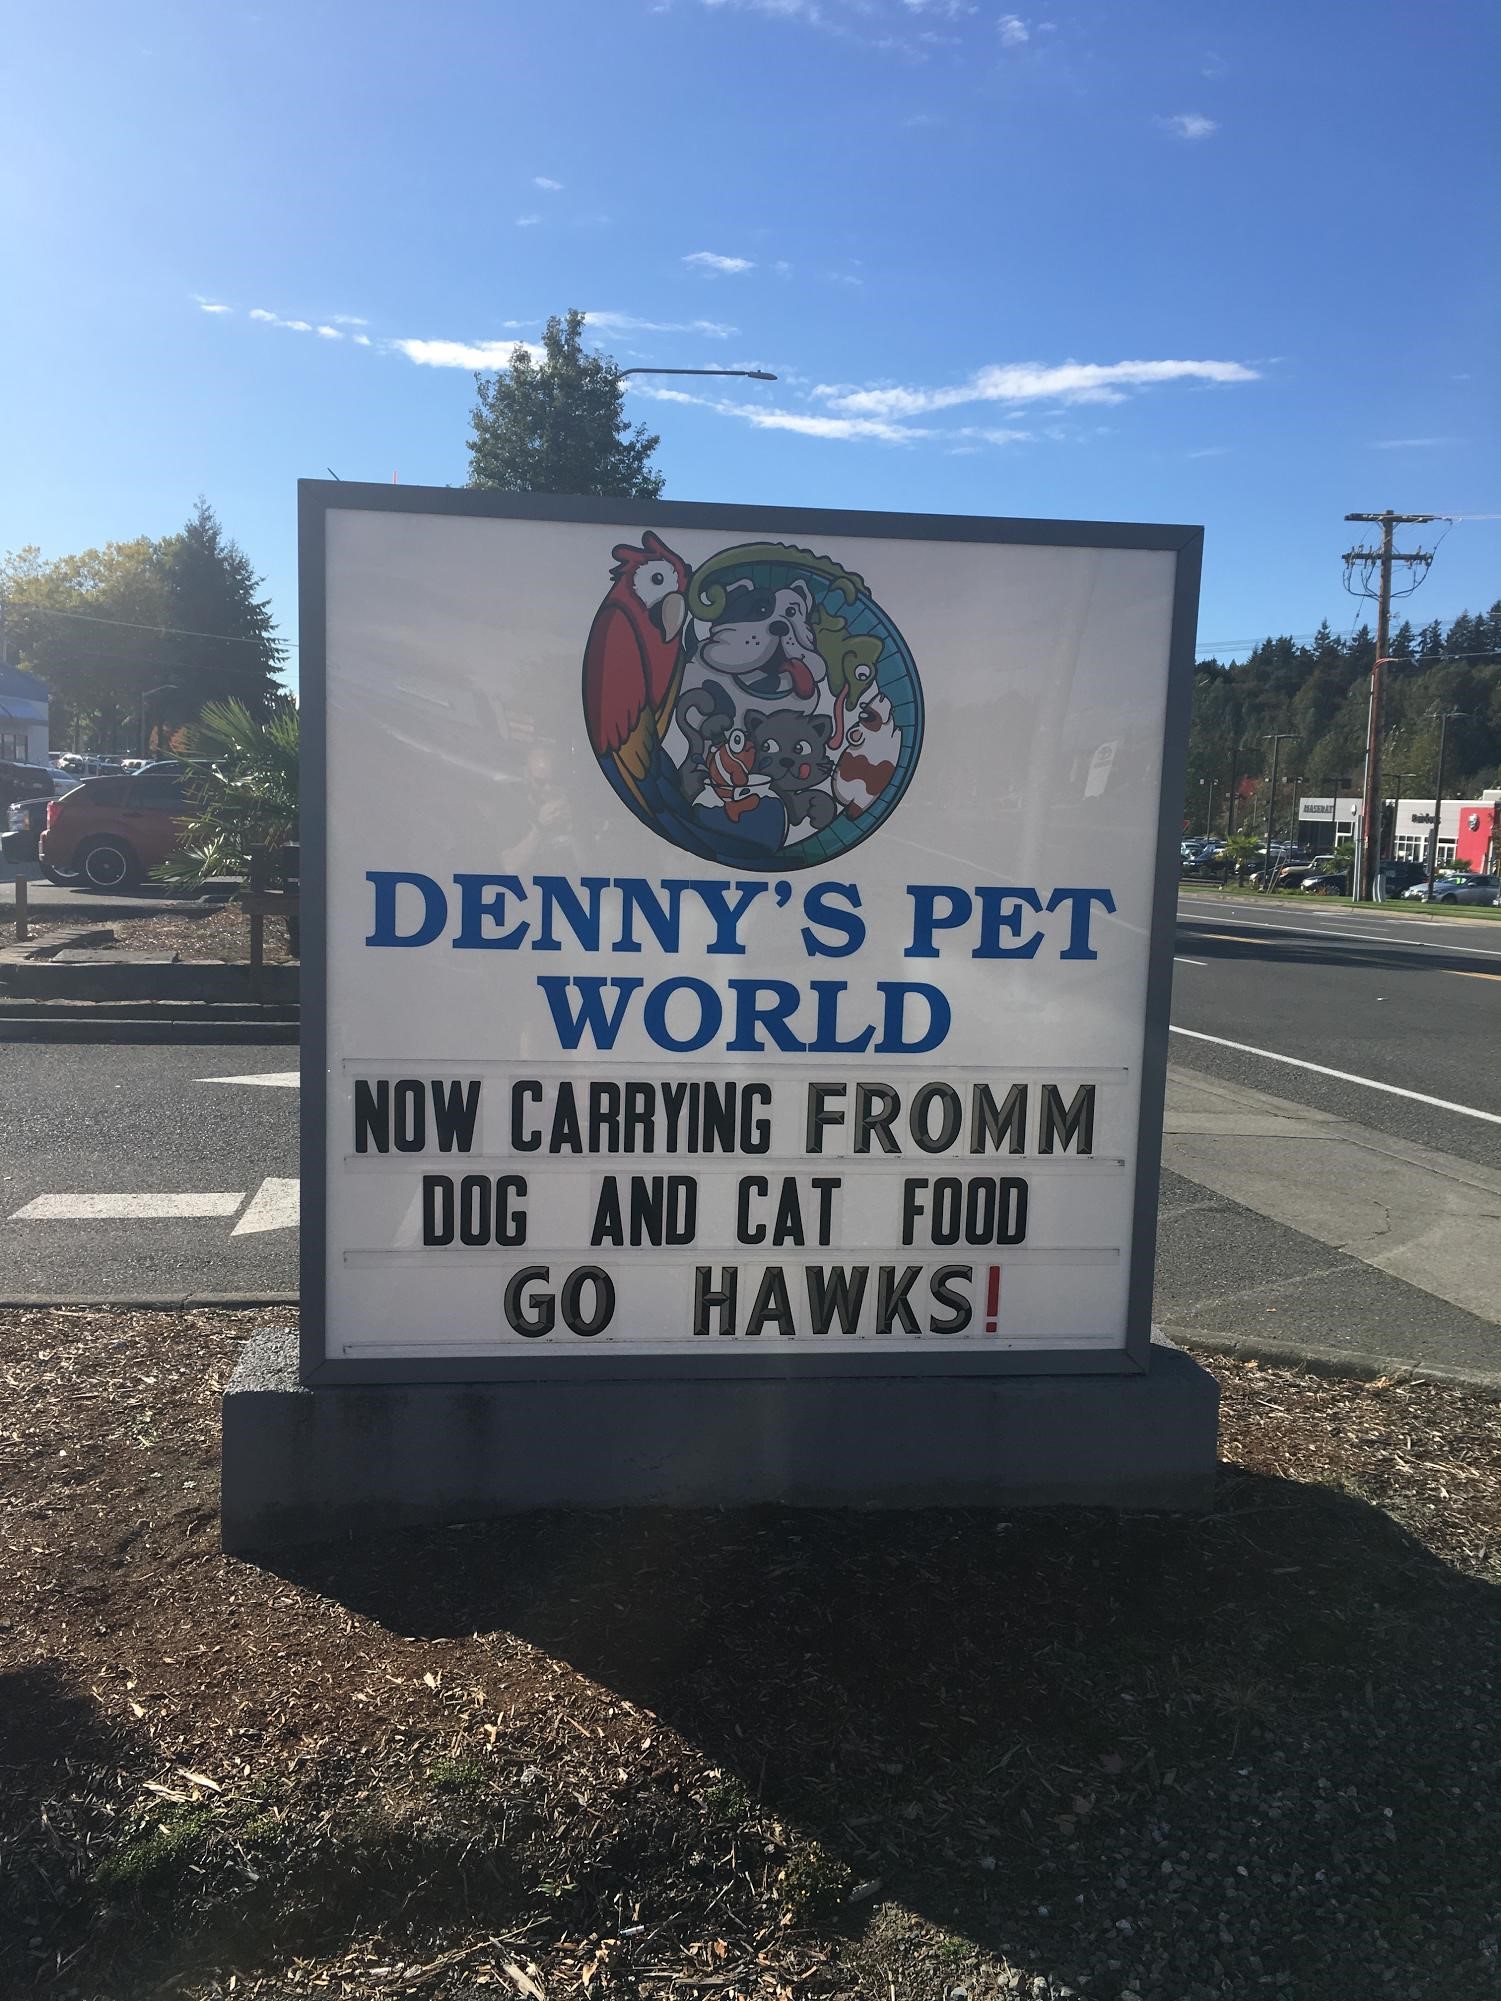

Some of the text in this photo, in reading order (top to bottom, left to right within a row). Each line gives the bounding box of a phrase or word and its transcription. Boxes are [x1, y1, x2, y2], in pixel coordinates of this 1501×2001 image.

[1303, 804, 1335, 814] MASERAT
[365, 871, 1118, 961] DENNY'S PET
[536, 975, 952, 1054] WORLD
[354, 1079, 1097, 1155] NOW CARRYING FROMM
[422, 1174, 1029, 1247] DOG AND CAT FOOD
[503, 1264, 1001, 1338] GO HAWKS!
